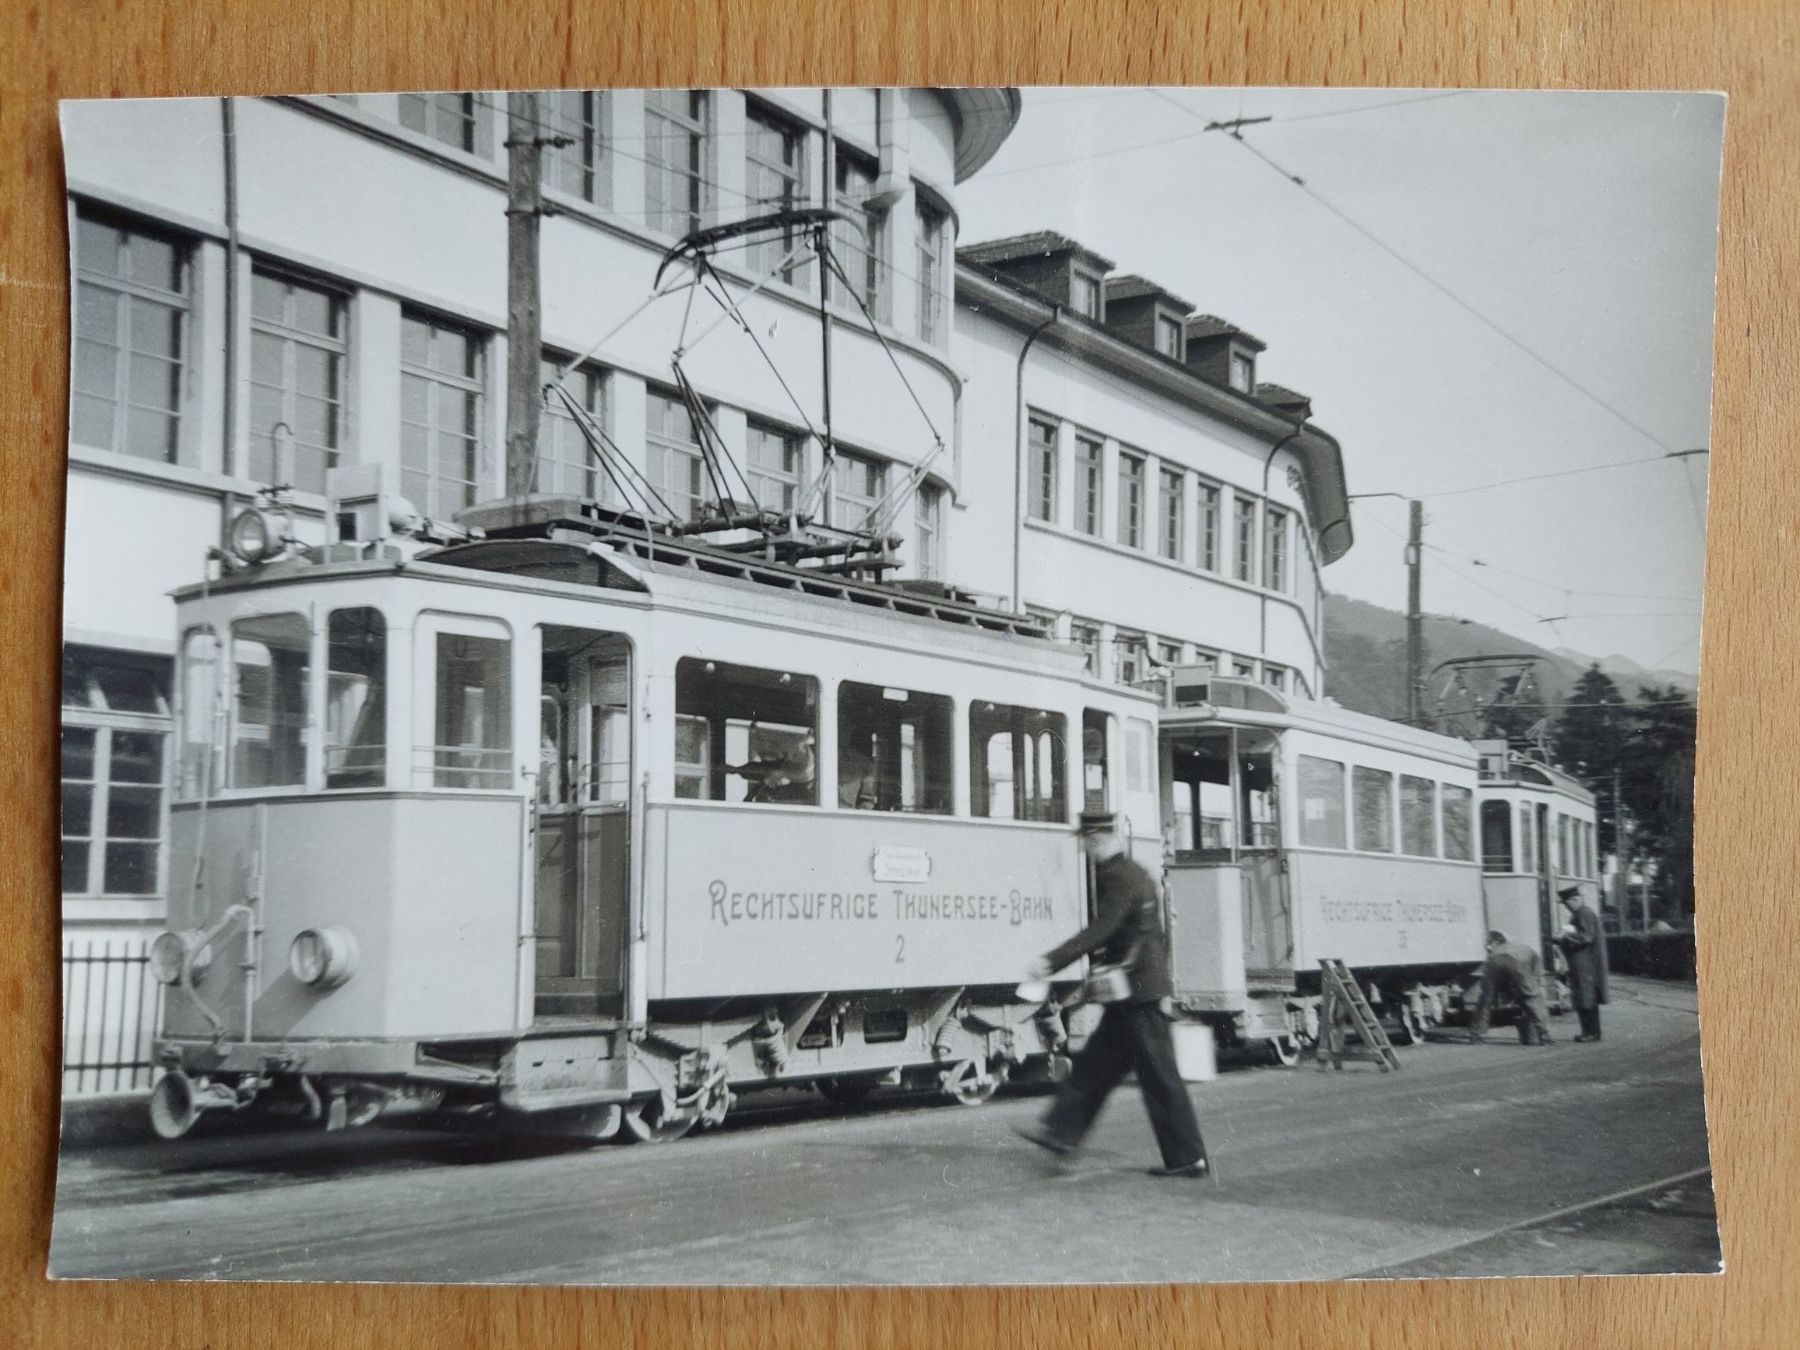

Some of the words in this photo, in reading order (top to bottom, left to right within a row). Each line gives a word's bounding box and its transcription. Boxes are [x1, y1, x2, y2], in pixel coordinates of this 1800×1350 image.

[708, 879, 878, 926] RECHTSUFRIGE
[893, 889, 1053, 926] THUNERSEE-BAHN
[895, 934, 905, 963] 2
